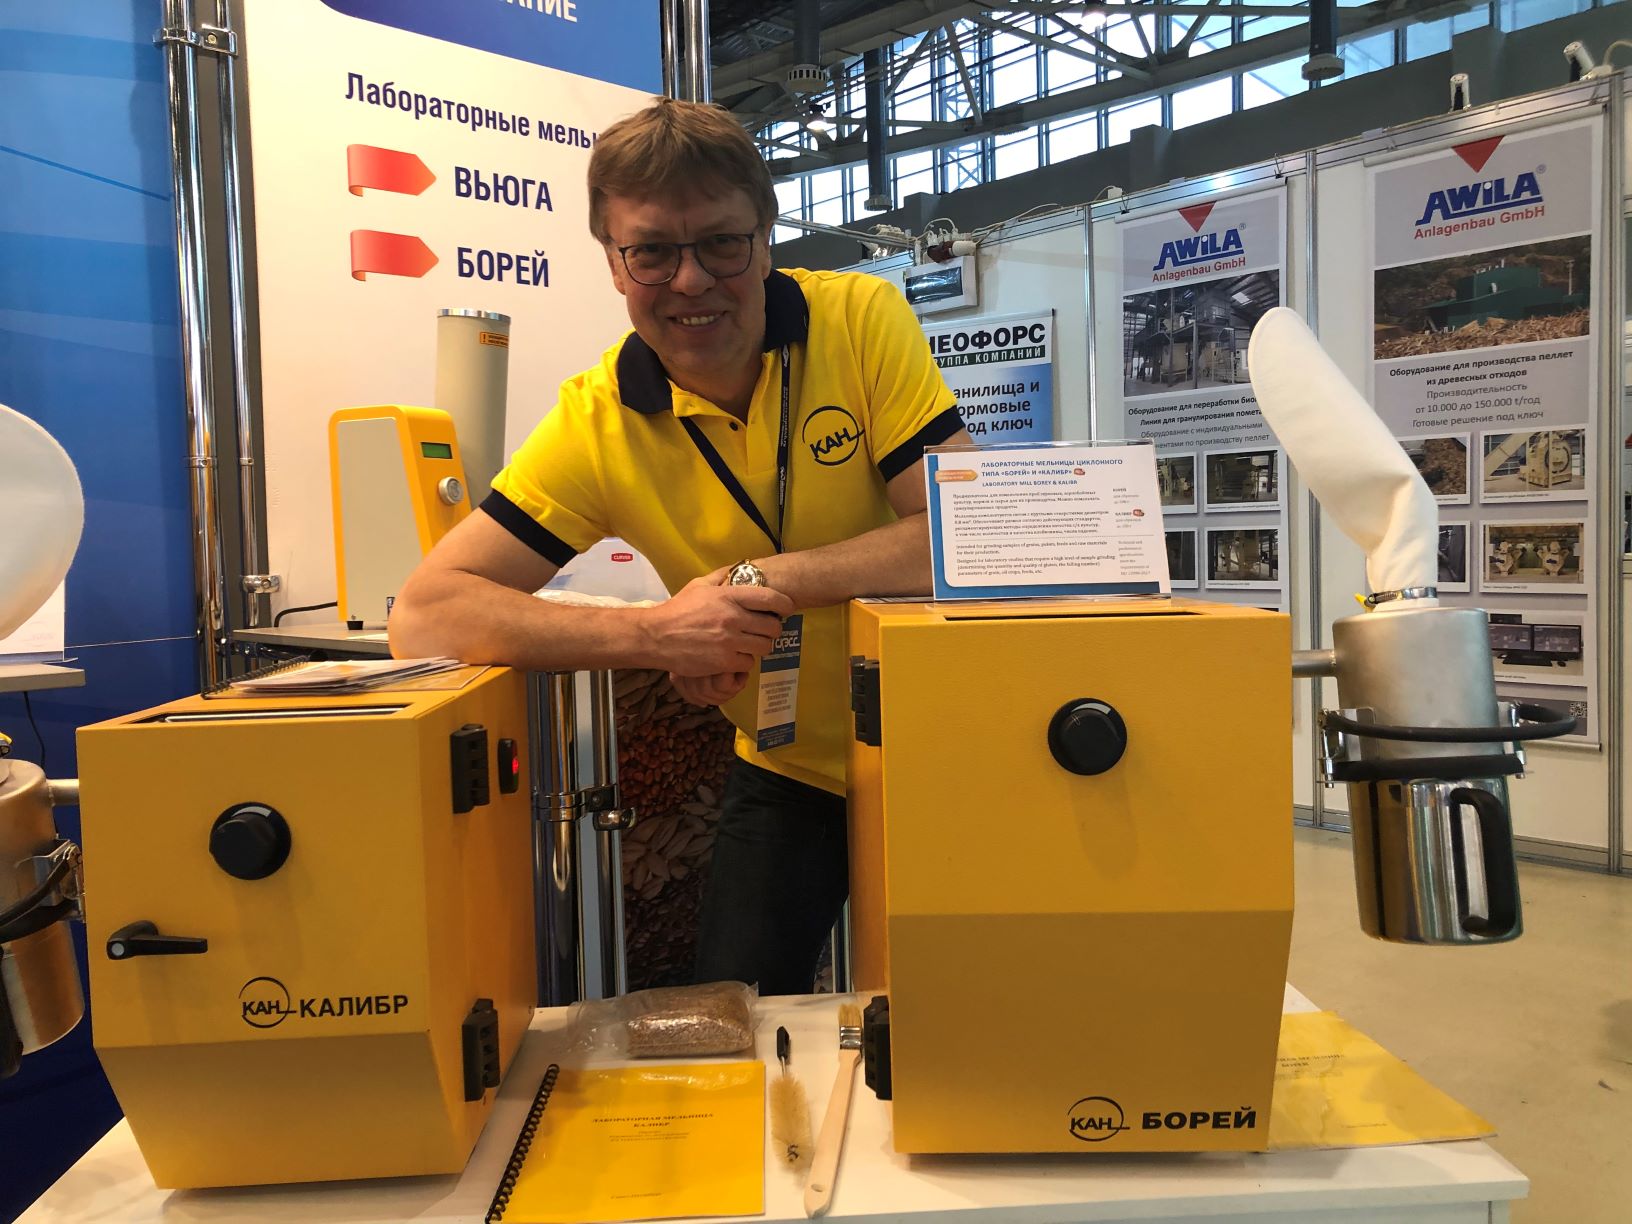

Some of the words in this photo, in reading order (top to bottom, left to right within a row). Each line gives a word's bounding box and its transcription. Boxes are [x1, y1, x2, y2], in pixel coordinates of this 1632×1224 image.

[345, 72, 530, 136] Лабораторные
[538, 120, 597, 149] мель
[455, 166, 553, 212] ВЬЮГА
[1414, 217, 1495, 239] Anlagenbau
[1500, 205, 1545, 224] GmbH
[457, 247, 549, 287] БОРЕЙ
[1152, 265, 1211, 282] Anlagenbau
[1213, 257, 1246, 272] GmbH
[975, 347, 1041, 363] КОМПАНИИ
[1390, 363, 1450, 378] Оборудование
[1453, 363, 1469, 372] для
[1472, 356, 1535, 369] производства
[1539, 352, 1574, 361] пеллет
[1438, 374, 1486, 386] древесных
[1489, 370, 1527, 381] отходов
[953, 382, 1025, 398] анилища
[1030, 381, 1039, 392] и
[1426, 382, 1528, 401] Производительность
[957, 400, 1031, 419] ормовые
[1128, 404, 1176, 418] Оборудование
[1179, 404, 1191, 413] для
[1193, 398, 1238, 411] переработки
[1428, 402, 1457, 412] 10.000
[1475, 397, 1512, 408] 150.000
[966, 421, 987, 435] од
[991, 418, 1033, 431] ключ
[1140, 417, 1160, 426] Линия
[1163, 418, 1174, 426] для
[1177, 413, 1234, 424] гранулирования
[1412, 417, 1447, 428] Готовые
[1450, 416, 1492, 427] решение
[1496, 414, 1514, 423] под
[1140, 427, 1188, 440] Оборудование
[1195, 423, 1263, 435] индивидуальными
[1195, 437, 1241, 447] производству
[300, 995, 408, 1018] КАЛИБР
[1142, 1106, 1256, 1130] БОРЕЙ
